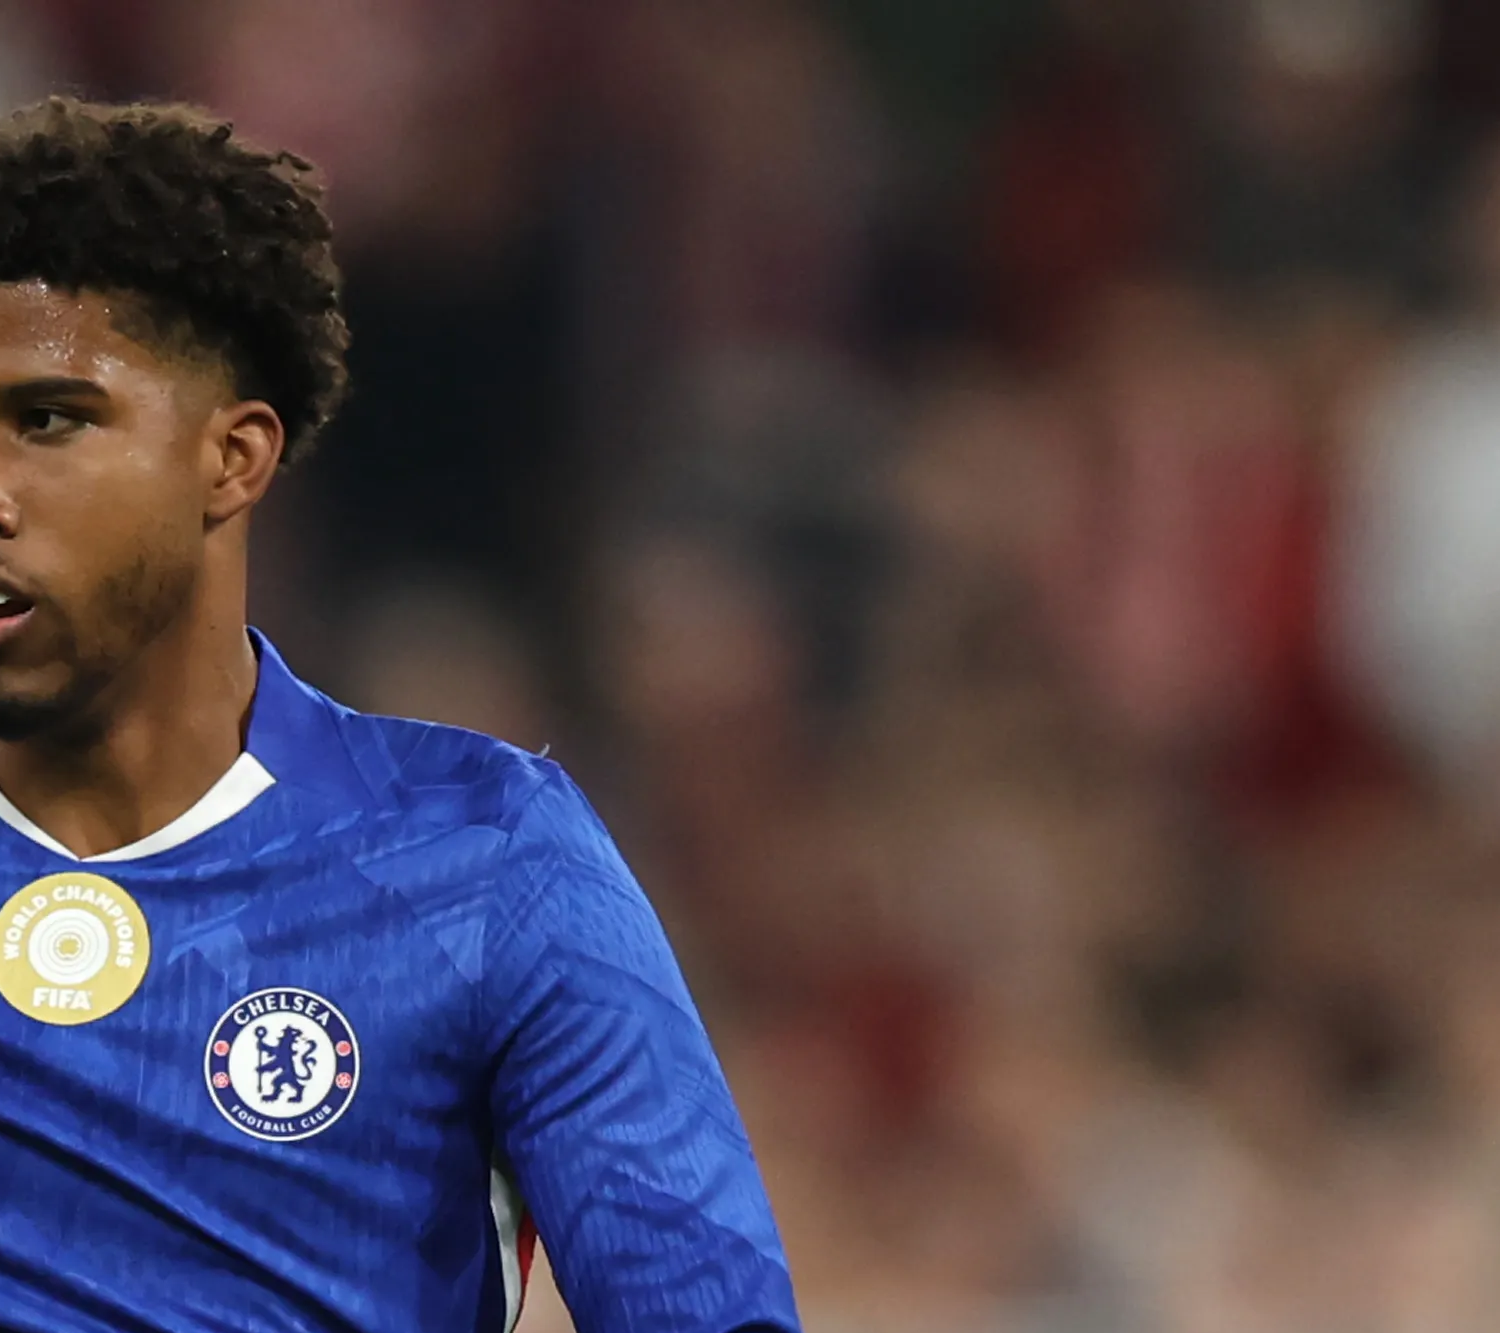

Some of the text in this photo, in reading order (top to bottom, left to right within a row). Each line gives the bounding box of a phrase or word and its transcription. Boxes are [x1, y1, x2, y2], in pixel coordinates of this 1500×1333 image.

[3, 885, 135, 969] WORLD CHAMPIONS
[32, 986, 91, 1010] FIFA
[233, 994, 332, 1027] CHELSEA
[230, 1104, 333, 1133] FOOTBALL CLUB
